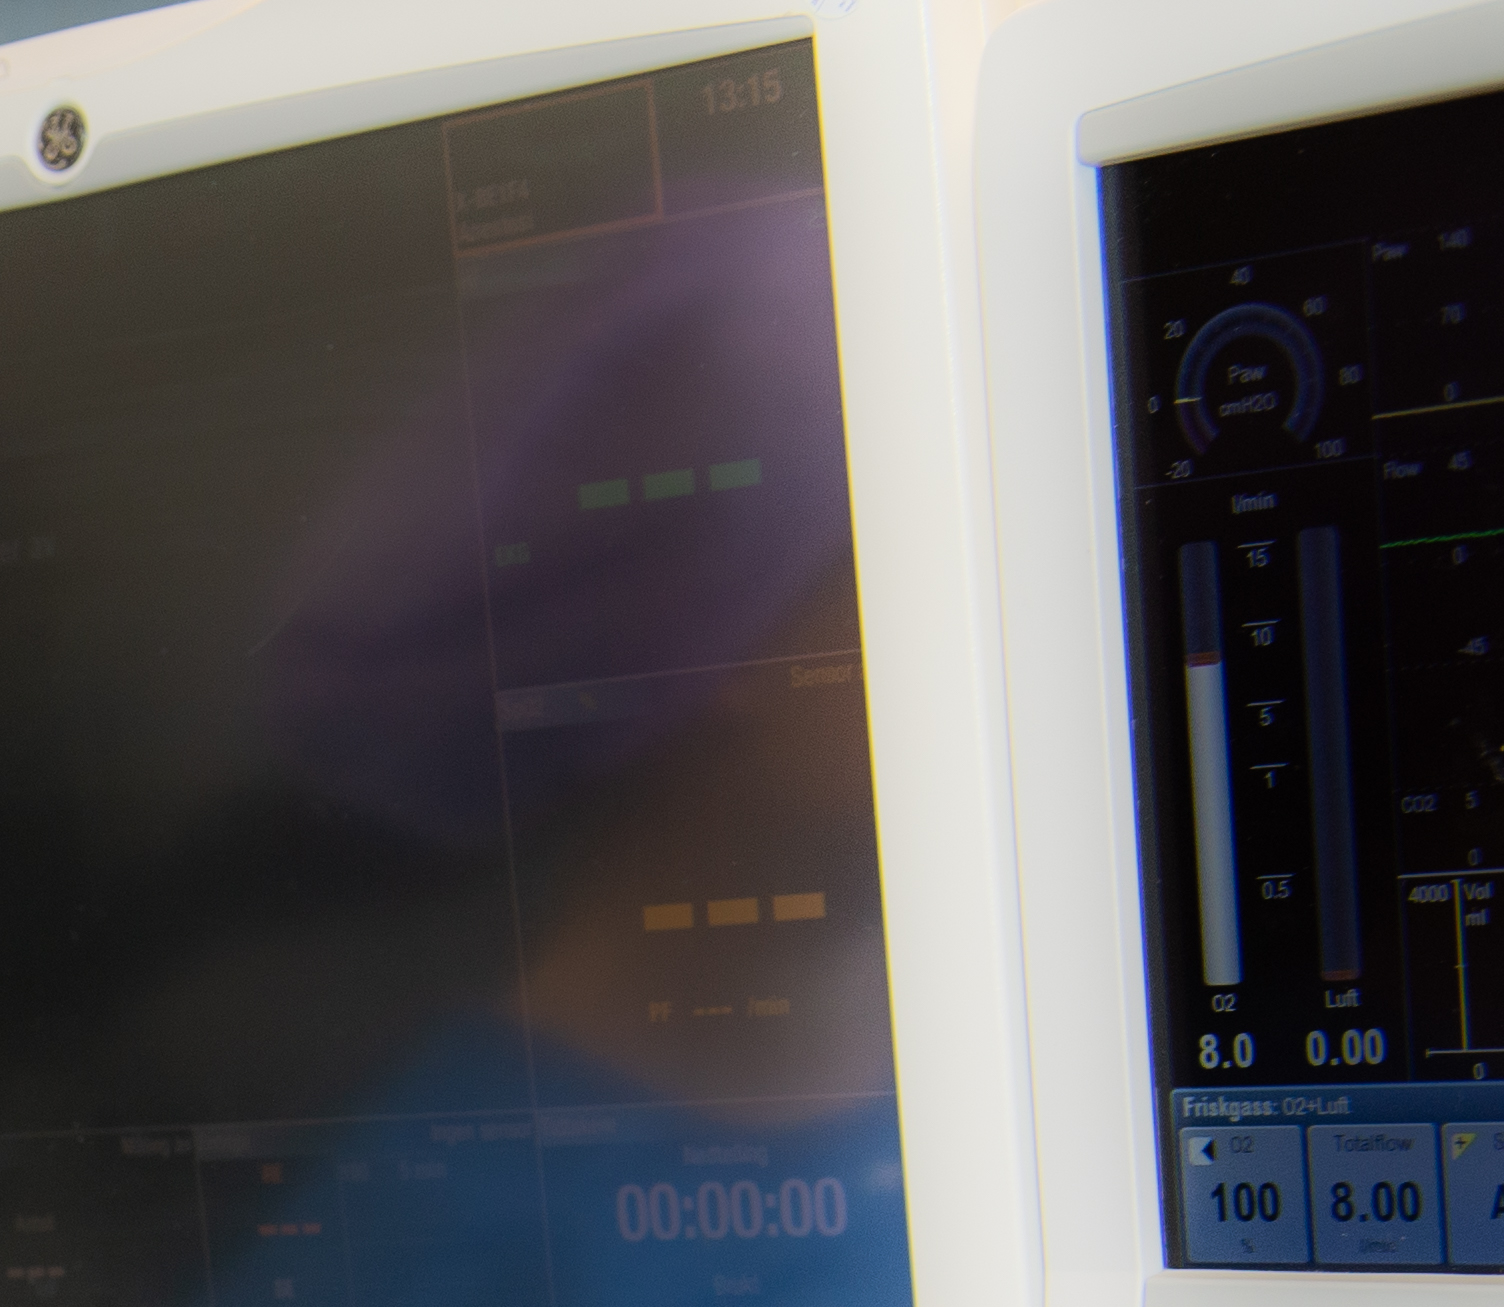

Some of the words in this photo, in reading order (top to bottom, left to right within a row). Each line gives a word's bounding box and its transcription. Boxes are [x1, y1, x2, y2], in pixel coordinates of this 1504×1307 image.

[701, 67, 784, 117] 13:15
[1372, 242, 1407, 262] Paw
[1230, 267, 1251, 286] 40
[1164, 321, 1185, 340] 20
[1228, 363, 1265, 384] Paw
[1383, 459, 1420, 480] Flow
[1246, 548, 1268, 569] 15
[1250, 628, 1273, 648] 10
[1258, 707, 1272, 727] 5
[1264, 771, 1275, 789] 1
[1401, 794, 1435, 814] CO2
[1261, 880, 1290, 900] 0.5
[1408, 884, 1449, 903] 4000
[1211, 994, 1236, 1013] O2
[1325, 989, 1360, 1010] Luft
[1198, 1033, 1255, 1069] 8.0
[1305, 1029, 1387, 1066] 0.00
[1182, 1096, 1279, 1120] Friskgass:
[1334, 1133, 1412, 1154] Totalflow
[616, 1176, 849, 1241] 00:00:00
[1210, 1182, 1281, 1223] 100
[1330, 1181, 1422, 1223] 8.00
